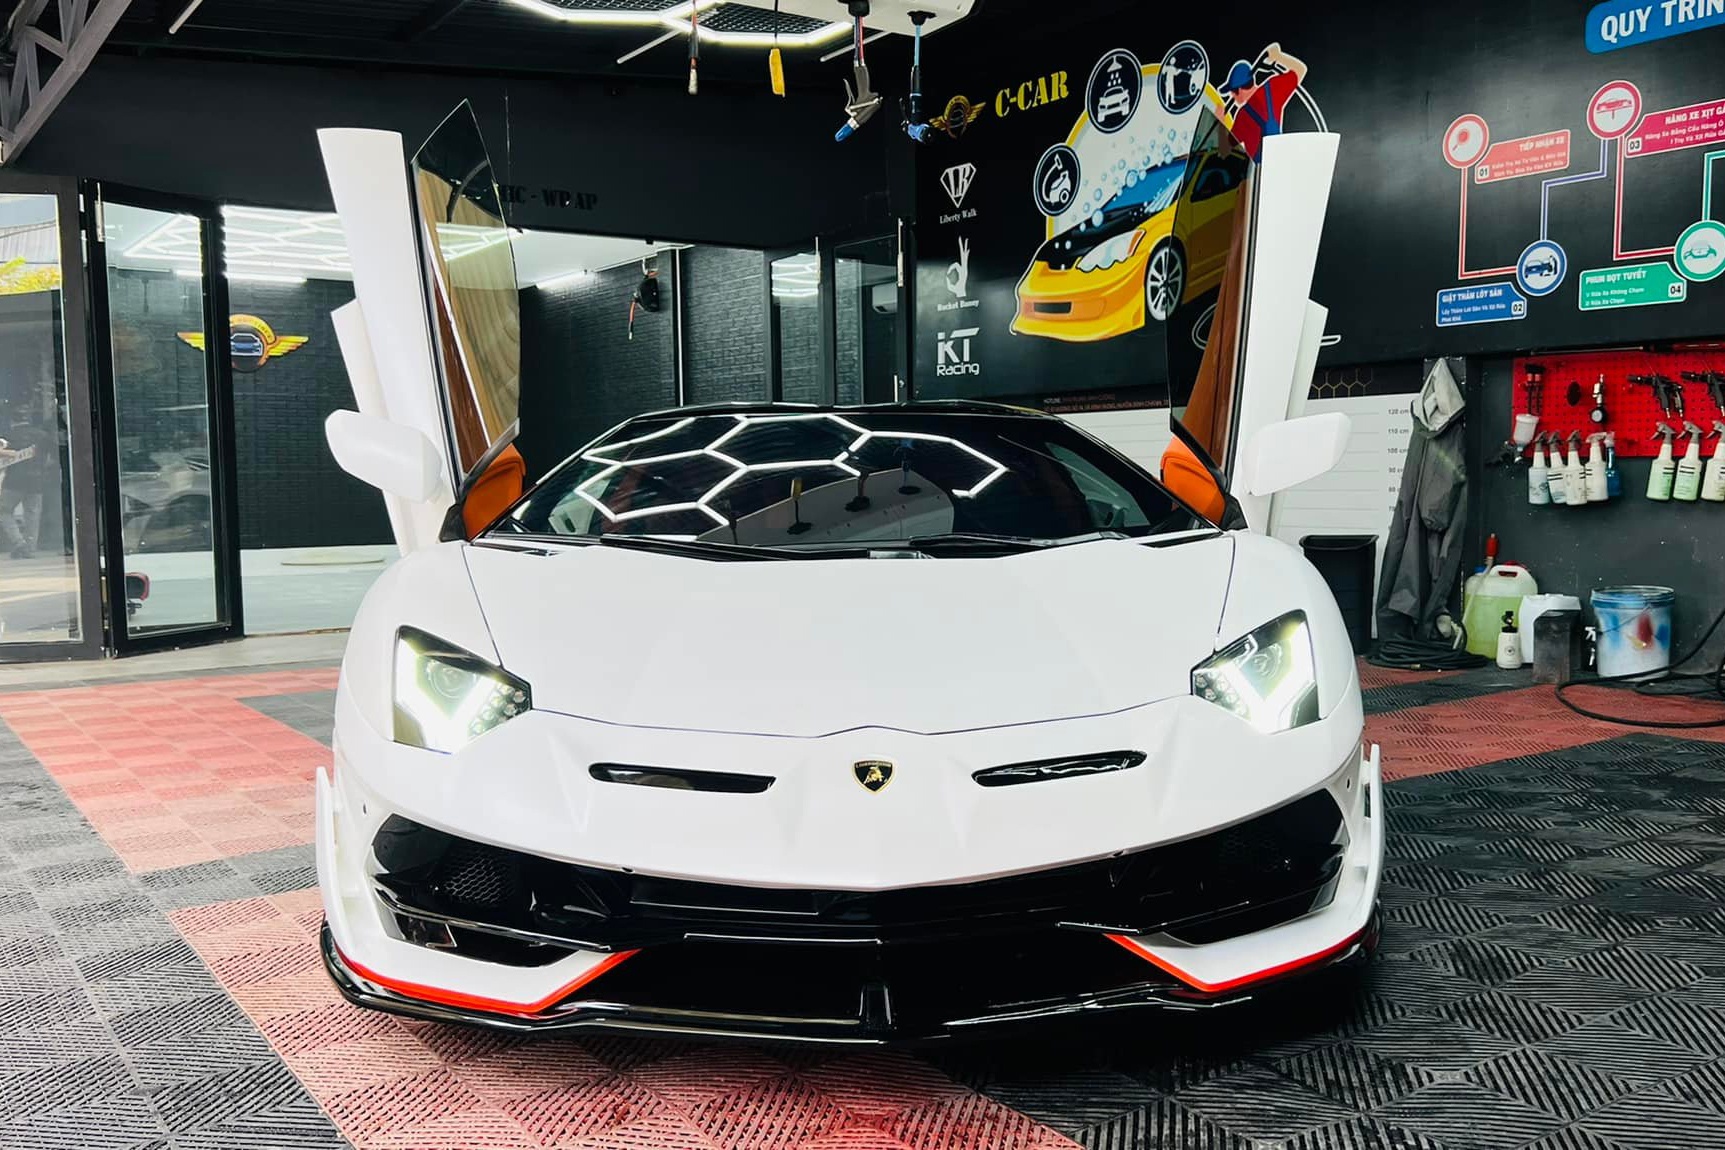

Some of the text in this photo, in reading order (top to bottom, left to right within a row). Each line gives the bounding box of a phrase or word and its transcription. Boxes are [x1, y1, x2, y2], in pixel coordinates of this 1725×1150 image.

[1601, 5, 1652, 43] QUY
[995, 70, 1069, 117] C-CAR
[1629, 140, 1640, 150] 03
[1480, 168, 1488, 176] 01
[940, 208, 977, 224] Liberty Walk
[1670, 285, 1681, 294] 04
[1512, 304, 1523, 312] 02
[936, 362, 980, 376] Racing
